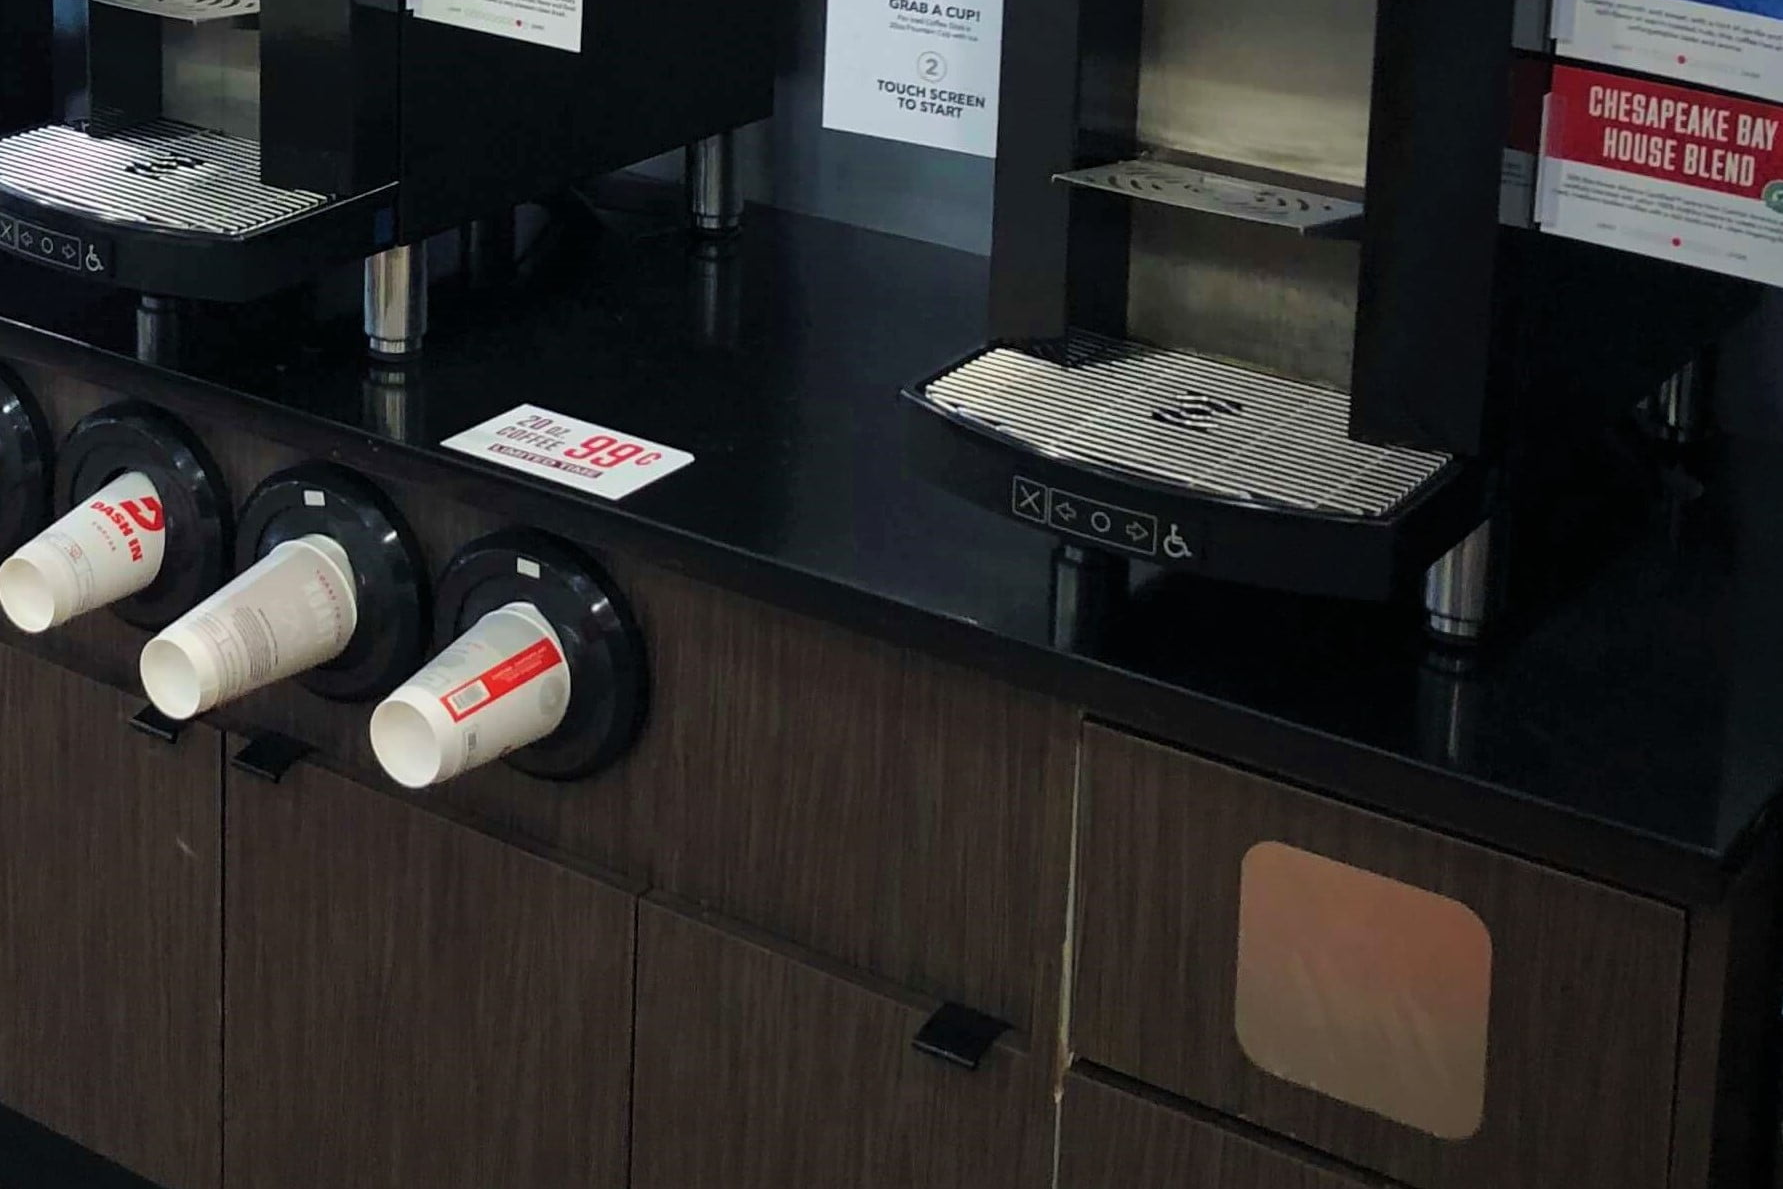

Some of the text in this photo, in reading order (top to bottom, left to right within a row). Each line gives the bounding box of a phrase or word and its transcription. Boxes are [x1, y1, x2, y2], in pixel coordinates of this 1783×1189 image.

[931, 3, 943, 17] A
[946, 6, 981, 23] CUP!
[876, 79, 986, 109] TOUCH SCREEN
[897, 97, 963, 119] TO START
[1588, 85, 1779, 151] CHESAPEAKE BAY
[1602, 127, 1756, 187] HOUSE BLEND
[517, 415, 554, 430] 20
[496, 426, 566, 452] COFFEE
[90, 501, 144, 562] DASH IN
